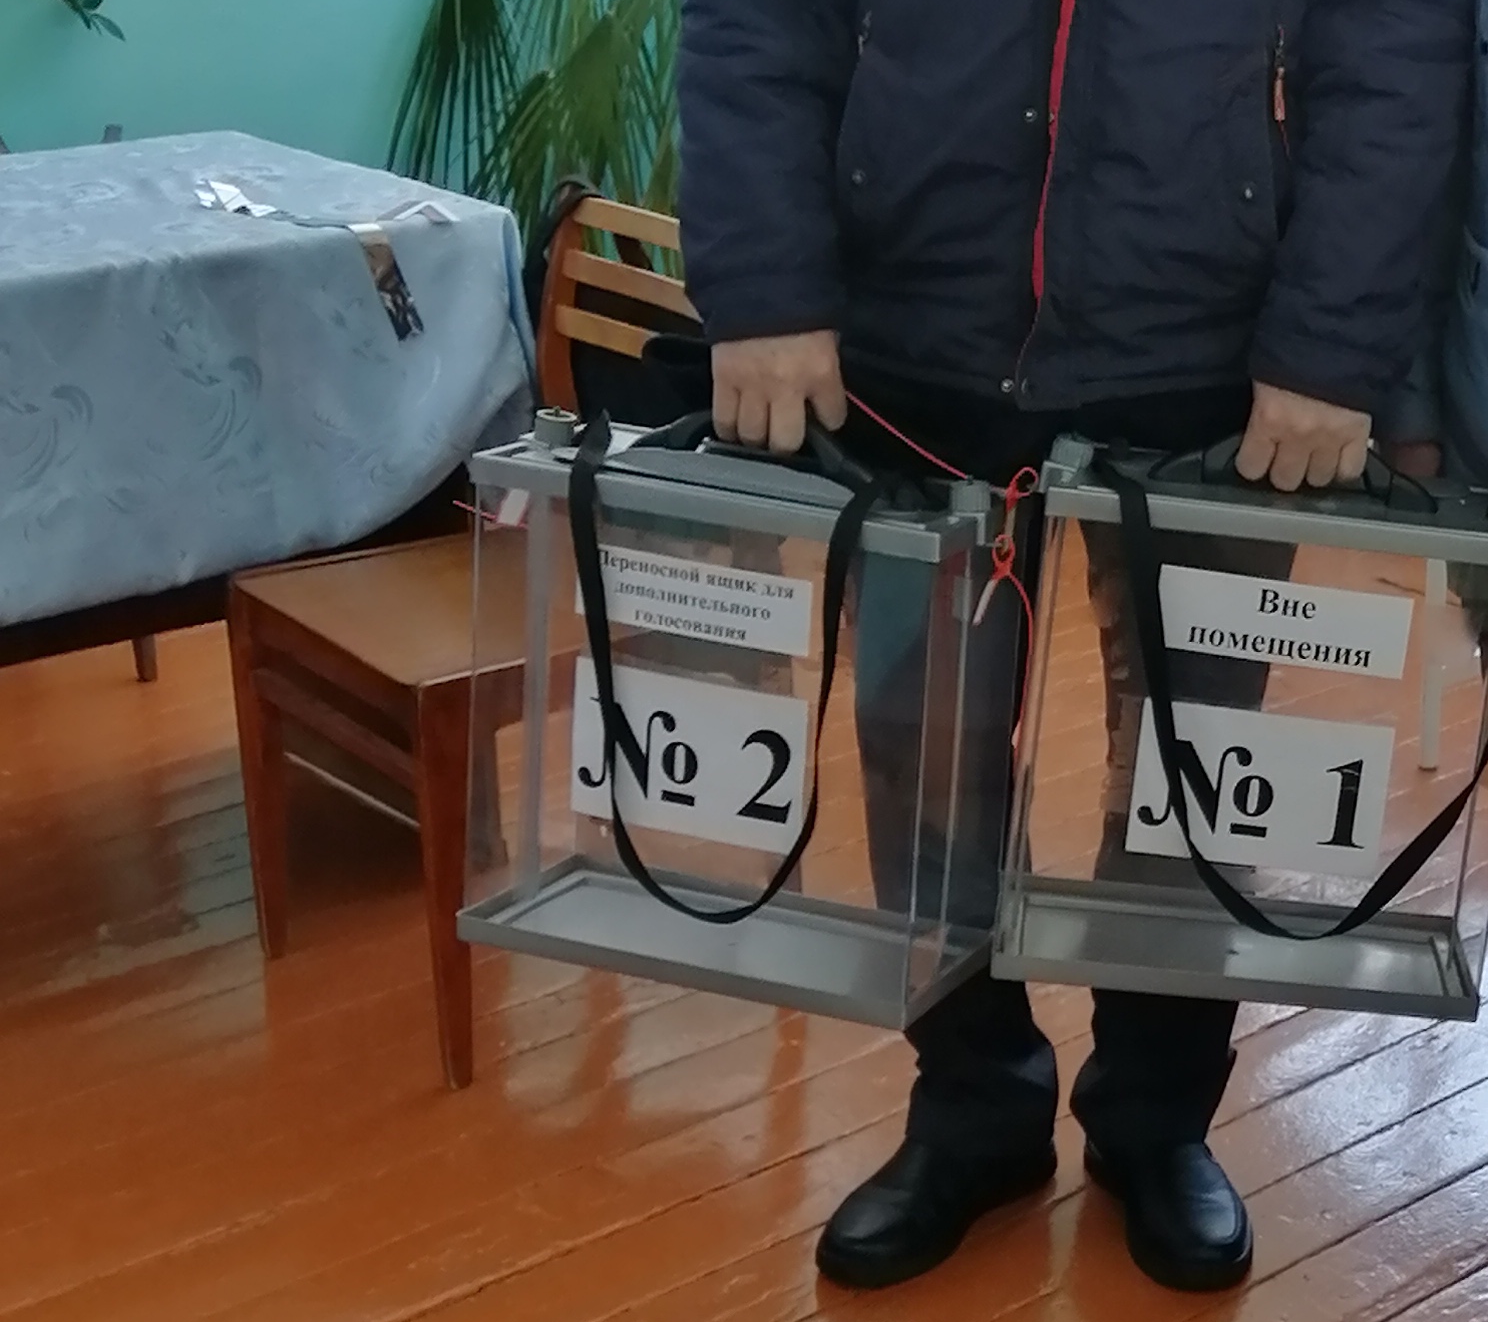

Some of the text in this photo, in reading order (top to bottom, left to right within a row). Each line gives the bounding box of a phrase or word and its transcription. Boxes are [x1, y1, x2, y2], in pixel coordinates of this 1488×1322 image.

[598, 550, 795, 600] Переносной ящик для
[614, 580, 772, 621] дополнительного
[1257, 588, 1317, 619] Вне
[633, 609, 747, 641] голосования
[1187, 626, 1372, 668] помещения
[736, 729, 793, 825] 2
[1315, 758, 1365, 850] 1
